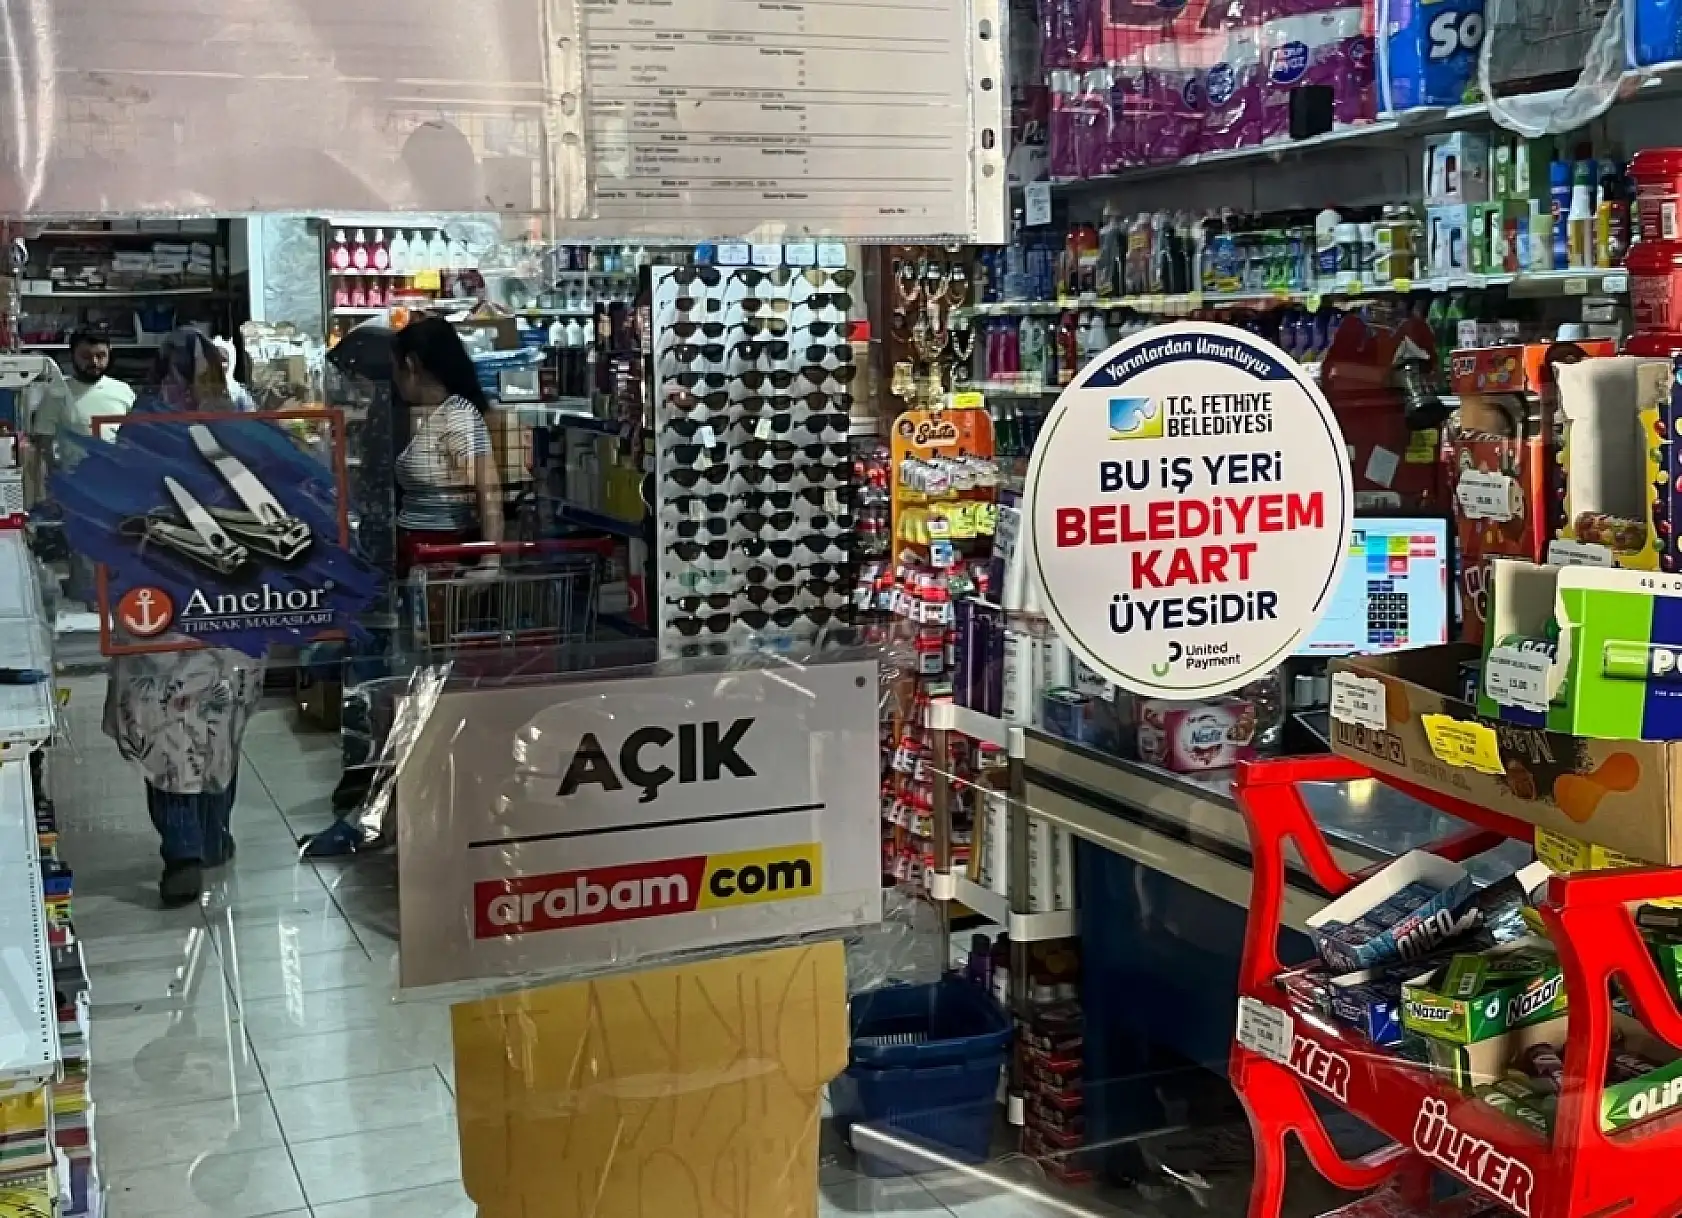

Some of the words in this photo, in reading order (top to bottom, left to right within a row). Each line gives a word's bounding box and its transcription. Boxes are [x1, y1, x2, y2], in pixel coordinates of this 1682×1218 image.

[1167, 396, 1196, 415] T.C.
[1101, 460, 1149, 492] BU
[1132, 543, 1257, 589] KART
[181, 584, 326, 617] Anchor
[1186, 642, 1228, 656] United
[1186, 655, 1240, 670] Payment
[556, 717, 757, 803] AÇIK
[487, 874, 688, 926] arabam
[710, 859, 812, 897] com
[1410, 1003, 1453, 1021] Nazar
[1507, 974, 1563, 1027] Nazar
[1414, 1097, 1533, 1217] ÜLKER
